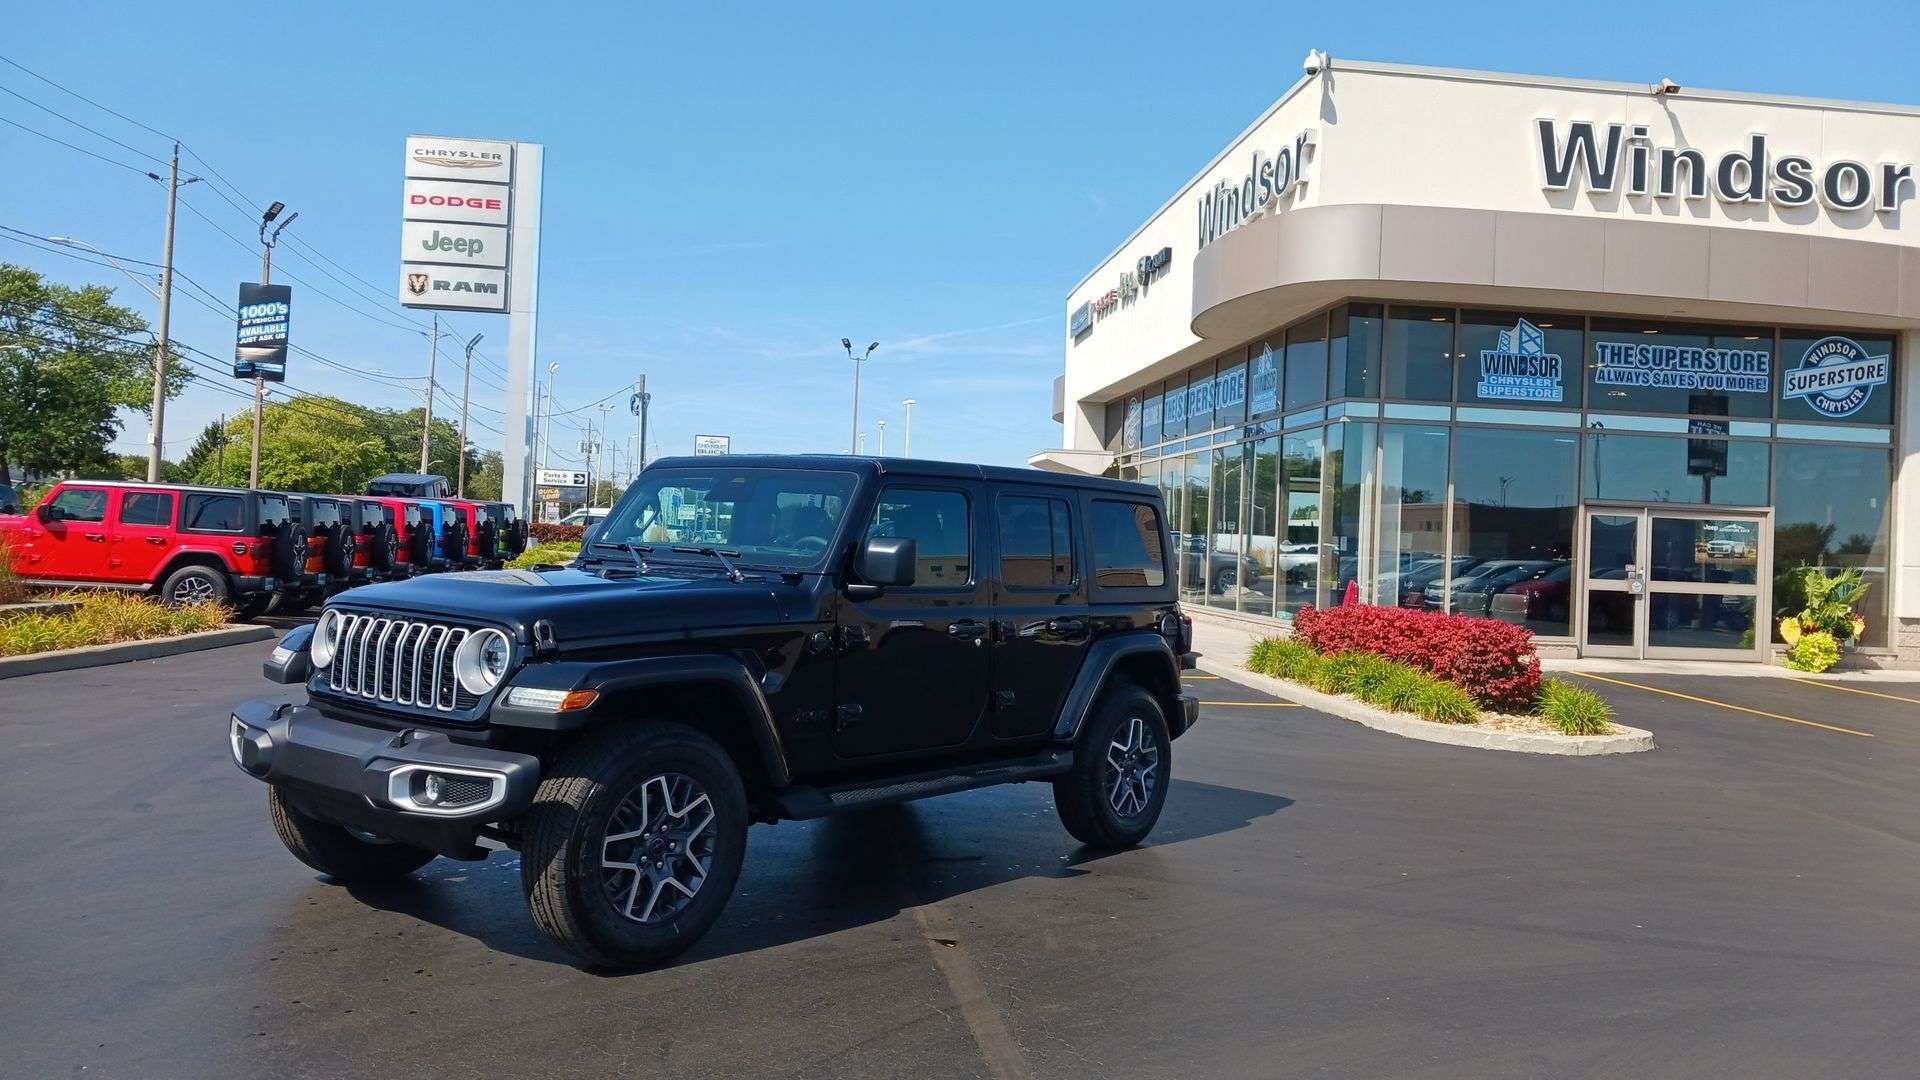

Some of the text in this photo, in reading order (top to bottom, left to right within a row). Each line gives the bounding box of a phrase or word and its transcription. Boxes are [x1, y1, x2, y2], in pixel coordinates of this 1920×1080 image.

[414, 148, 502, 160] CHRYSLER
[1538, 118, 1912, 212] Windsor
[1199, 128, 1312, 250] Windsor
[410, 194, 502, 210] DODGE
[422, 230, 484, 257] Jeep
[433, 280, 498, 294] RAM
[240, 302, 288, 319] 1000's
[252, 315, 285, 324] VEHICLES
[239, 323, 288, 338] AVAILABLE
[239, 336, 257, 344] JUST
[1599, 344, 1768, 373] THE SUPERSTORE
[1809, 343, 1857, 364] WINDSOR
[1483, 353, 1559, 378] WINDSOR
[1489, 375, 1553, 387] CHRYSLER
[1598, 370, 1768, 391] ALWAYS SAVES YOU MORE!
[1788, 363, 1884, 391] SUPERSTORE
[1481, 385, 1560, 398] SUPERSTORE
[1816, 389, 1864, 412] CHRYSLER
